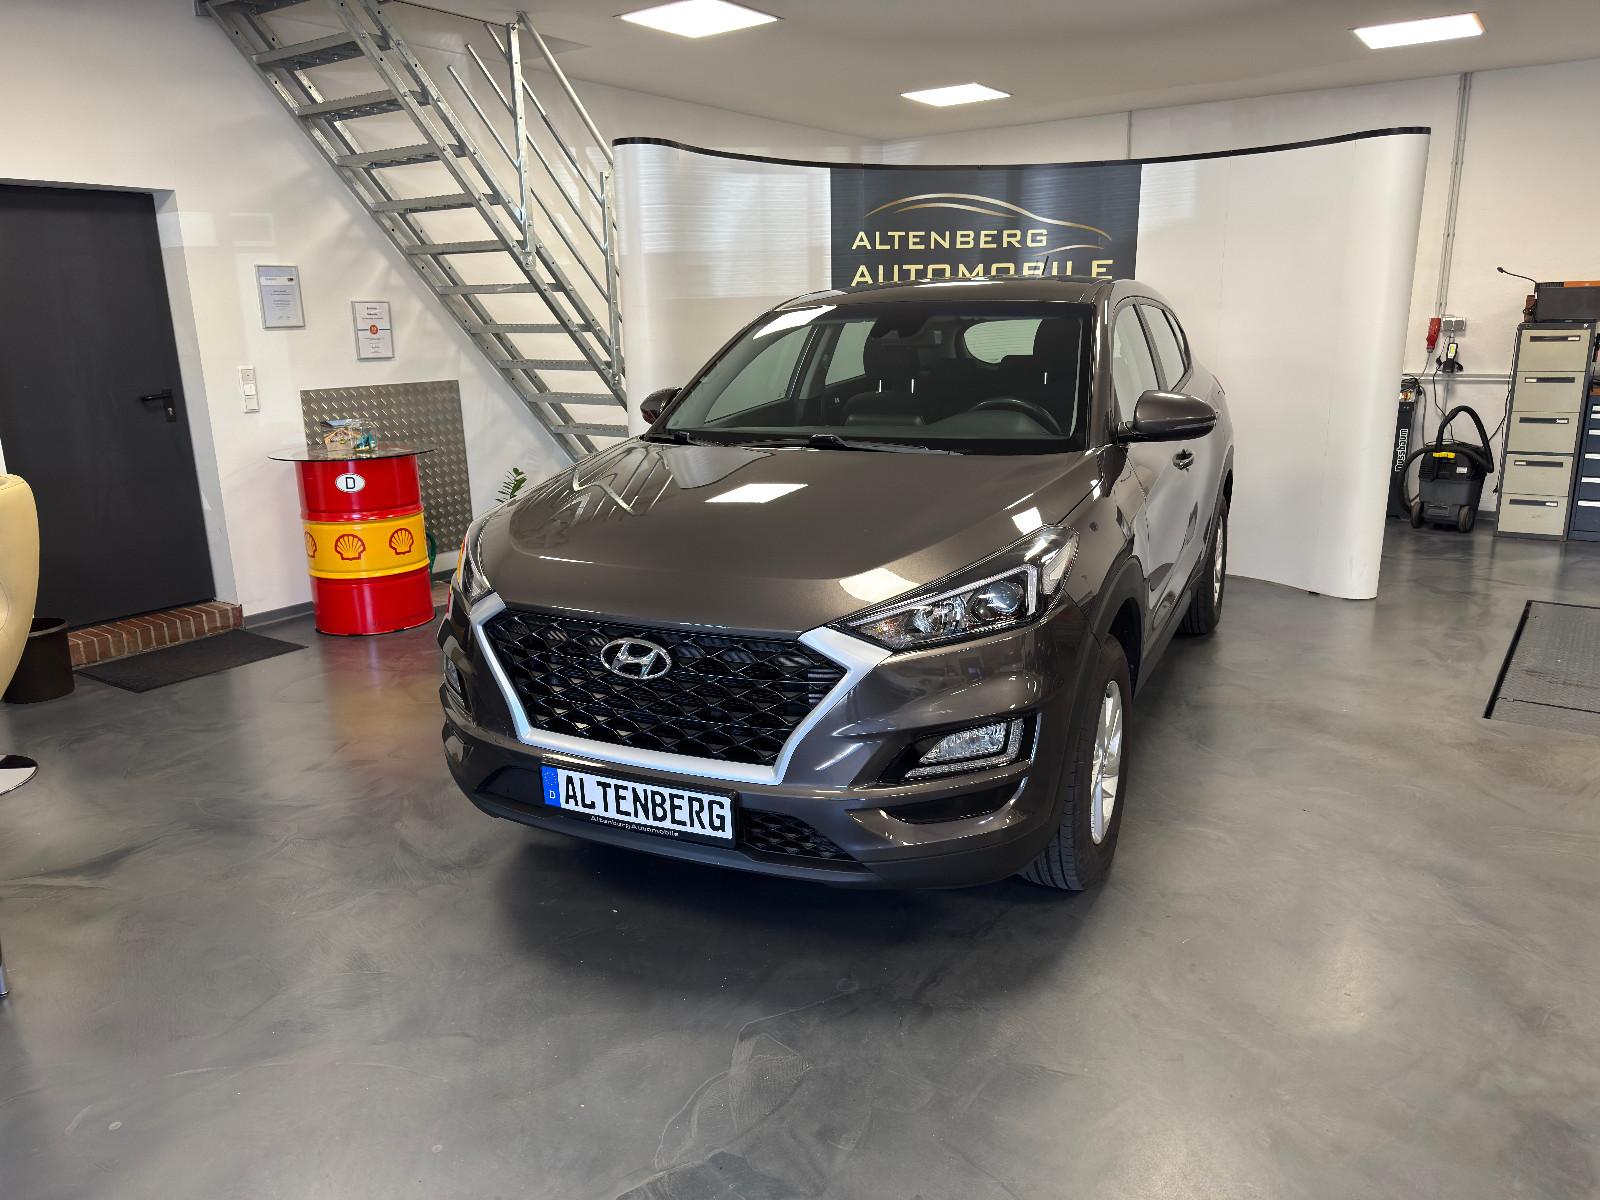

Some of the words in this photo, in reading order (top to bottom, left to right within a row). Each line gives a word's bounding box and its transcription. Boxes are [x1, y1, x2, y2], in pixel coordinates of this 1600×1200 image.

[851, 229, 1048, 250] ALTENBERG
[1394, 428, 1409, 472] nussbaum
[345, 476, 356, 490] D
[549, 790, 556, 800] D
[564, 774, 726, 833] ALTENBERG
